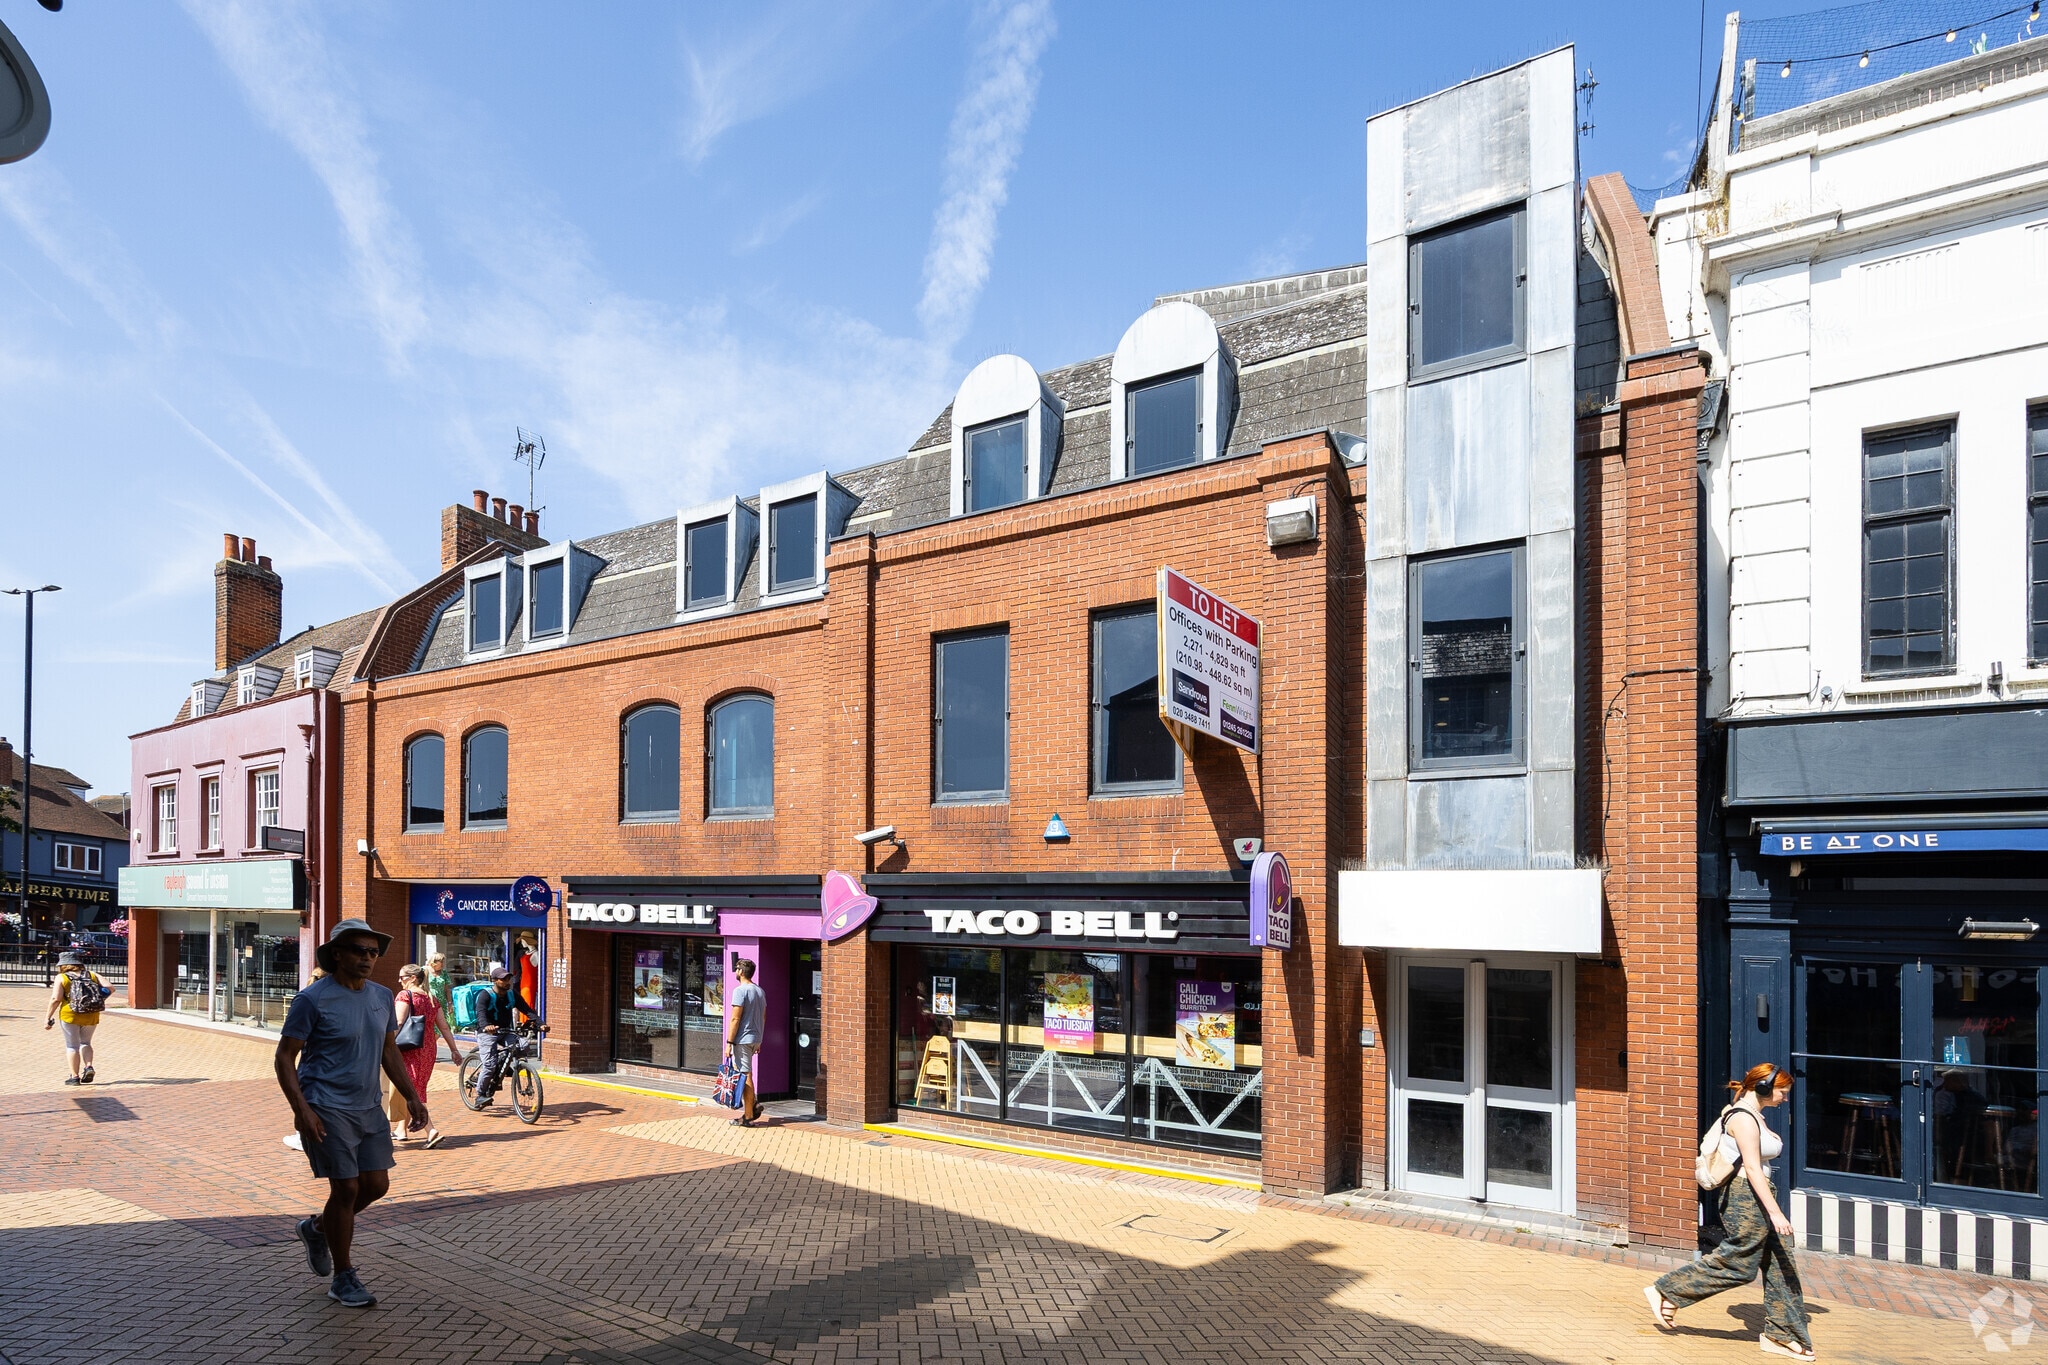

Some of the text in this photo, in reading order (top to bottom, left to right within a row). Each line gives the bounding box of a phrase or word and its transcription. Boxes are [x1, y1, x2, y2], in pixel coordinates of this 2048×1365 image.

[1188, 586, 1240, 634] TO LET
[1169, 606, 1256, 668] Offices with Parking
[1184, 635, 1202, 655] 2,271
[1210, 650, 1228, 668] 4,829
[1230, 662, 1238, 676] sq
[1240, 666, 1246, 678] ft
[1176, 649, 1202, 673] (210.98
[1208, 668, 1232, 688] 448.62
[1233, 682, 1242, 695] sq
[1244, 688, 1252, 700] m)
[1178, 681, 1208, 704] Sandrove
[1172, 706, 1184, 717] 020
[1198, 717, 1210, 730] 7411
[1782, 834, 1938, 850] BE AT ONE
[164, 870, 186, 898] rayleigh
[186, 868, 205, 889] sound
[210, 868, 228, 889] vision
[66, 888, 110, 903] TIME
[458, 900, 488, 911] CANCER
[566, 902, 636, 922] TACO
[923, 909, 1040, 936] TACO
[1269, 915, 1289, 930] TACO
[1270, 928, 1289, 944] BELL
[1180, 983, 1198, 994] CALI
[1180, 994, 1216, 1006] CHICKEN
[1045, 1018, 1093, 1032] TACO TUESDAY
[1203, 1071, 1226, 1079] NACHOS
[1228, 1079, 1248, 1088] TACOS
